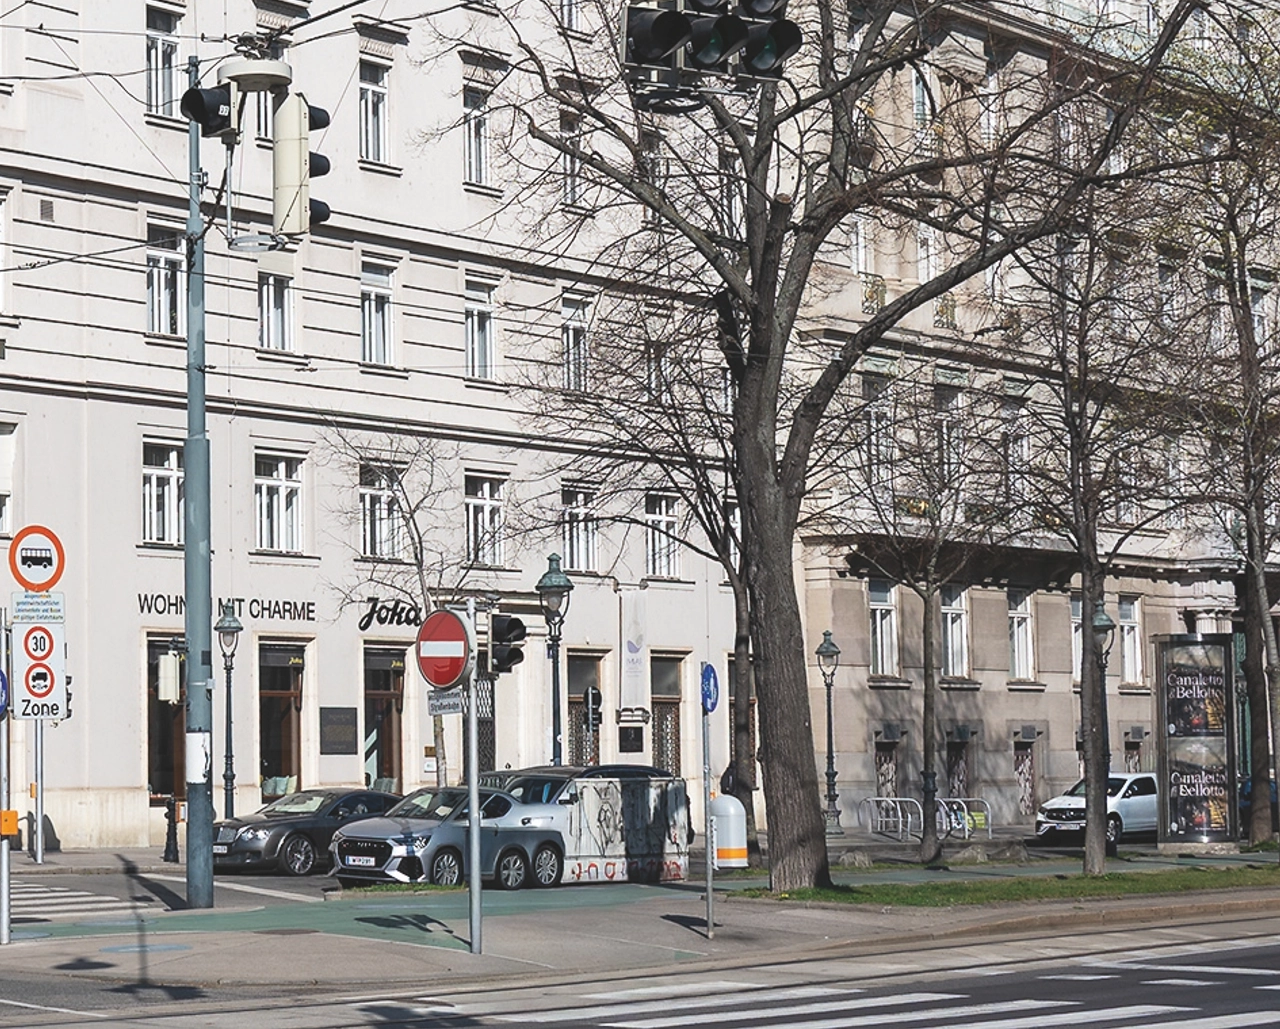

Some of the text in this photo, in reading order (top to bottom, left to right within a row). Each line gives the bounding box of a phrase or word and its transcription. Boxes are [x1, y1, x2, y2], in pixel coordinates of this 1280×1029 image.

[138, 593, 316, 621] WOHN MIT CHARME
[358, 597, 422, 631] Joka
[32, 636, 46, 652] 30
[1167, 673, 1223, 686] Canaletto
[21, 699, 60, 716] Zone
